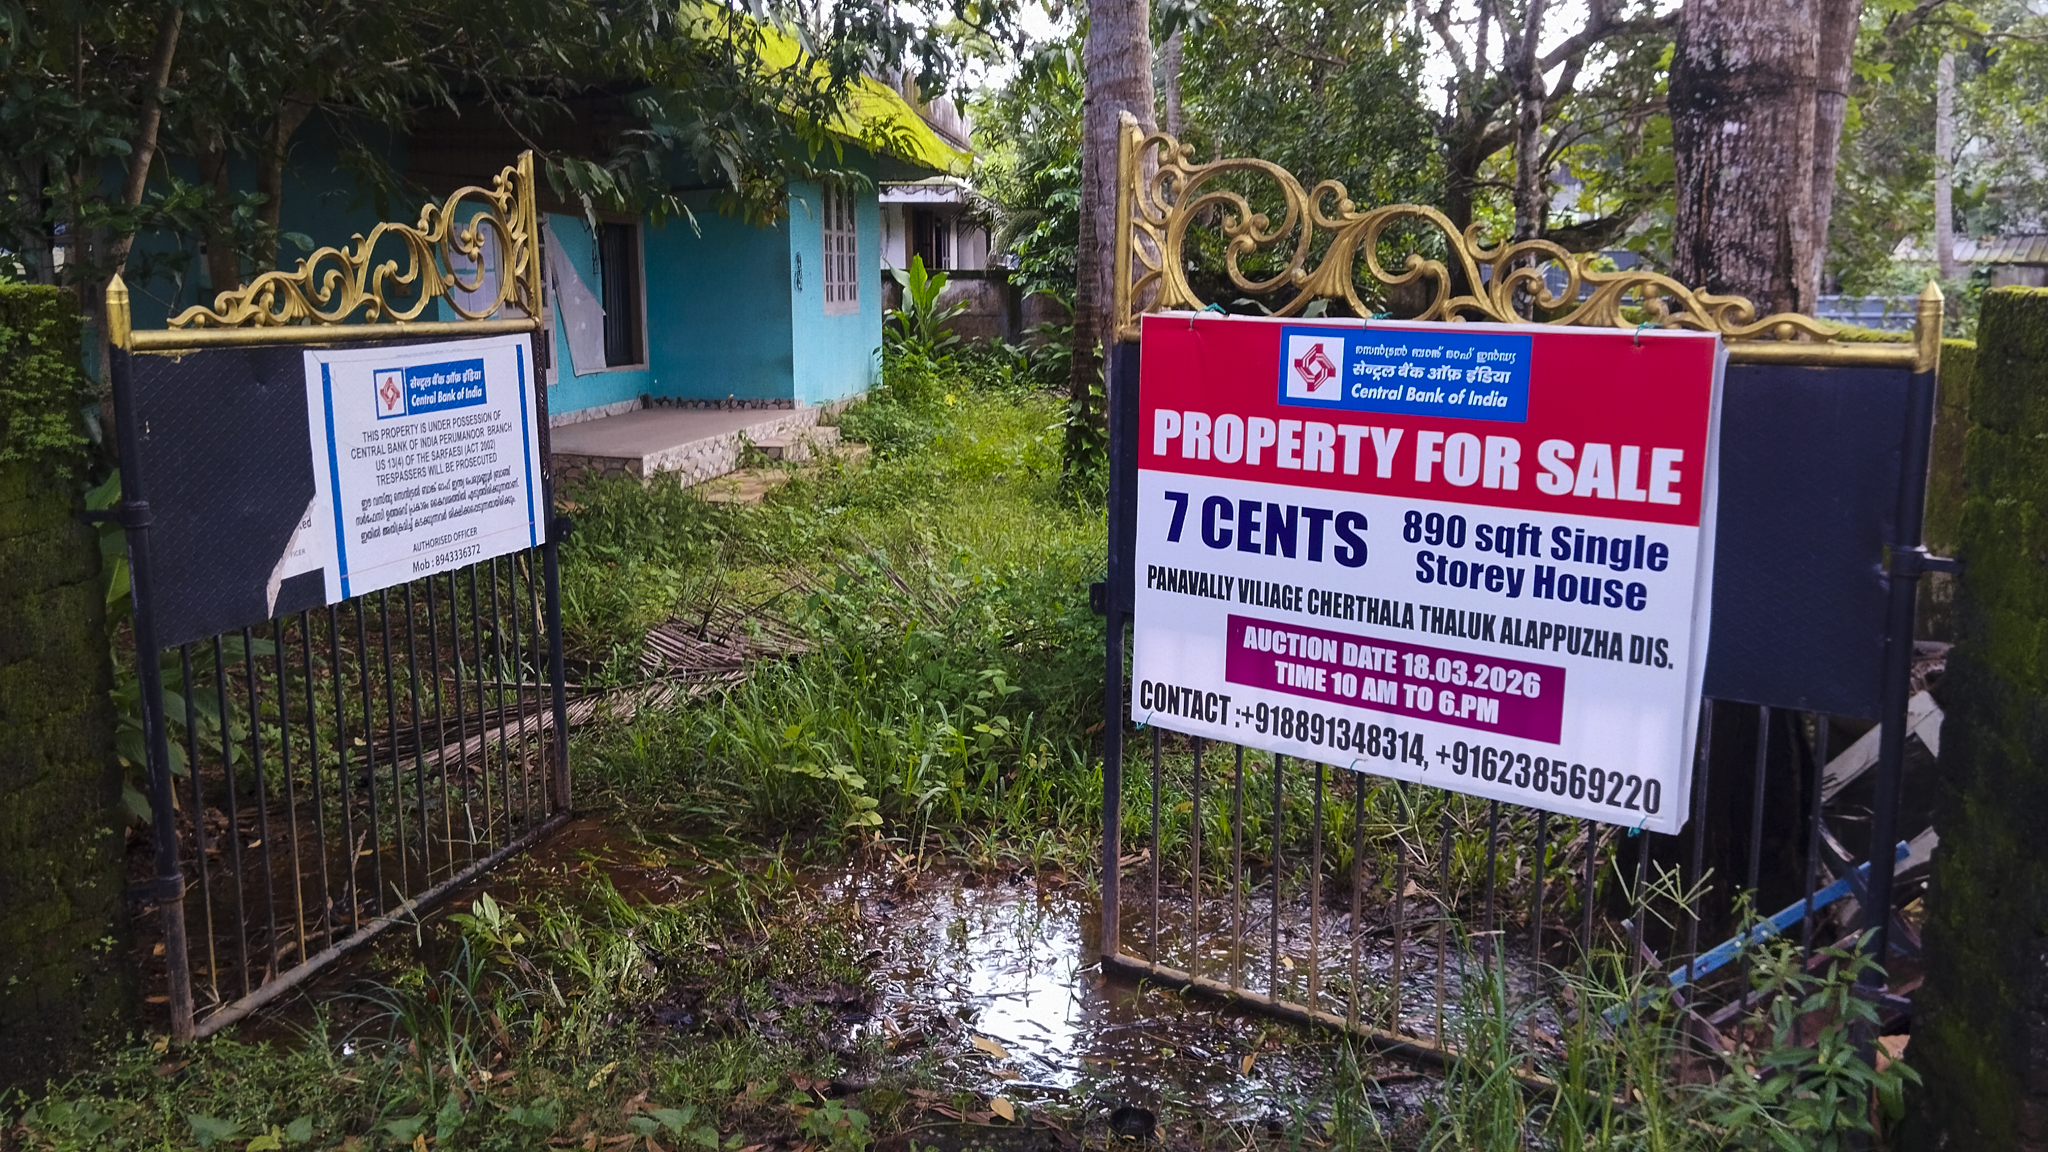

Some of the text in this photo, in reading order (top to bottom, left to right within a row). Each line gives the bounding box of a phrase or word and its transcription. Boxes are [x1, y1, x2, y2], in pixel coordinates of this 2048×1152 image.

[432, 373, 445, 385] बैंक
[463, 368, 481, 383] इंडिया
[1398, 362, 1425, 378] बैंक
[1466, 366, 1511, 383] इंडिया
[412, 385, 482, 407] Central Bank of India
[1352, 383, 1507, 407] Central Bank of India
[351, 422, 512, 459] CENTRAL BANK OF INDIA PERUMANOOR BRANCH
[362, 410, 500, 442] THIS PROPERTY IS UNDER POSSESSION OF
[376, 439, 496, 471] US 13(4) OF THE SARFAESI (ACT 2002)
[376, 453, 497, 486] TRESPASSERS WILL BE PROSECUTED
[1154, 409, 1683, 505] PROPERTY FOR SALE
[300, 516, 312, 530] ed
[413, 527, 477, 552] AUTHORISED OFFICER
[1165, 491, 1368, 568] 7 CENTS
[1403, 510, 1668, 571] 890 sqft Single
[413, 558, 430, 572] Mob
[436, 544, 480, 566] 8943336372
[1416, 551, 1647, 611] Storey House
[1148, 565, 1234, 601] PANAVALLY
[1308, 589, 1414, 630] CHERTHALA
[1419, 605, 1496, 642] THALUK
[1500, 617, 1623, 661] ALAPPUZHA
[1629, 635, 1673, 669] DIS.
[1243, 626, 1540, 698] AUCTION DATE 18.03.2026
[1275, 661, 1499, 724] TIME 10 AM TO 6.PM
[1140, 680, 1231, 725] CONTACT
[1436, 741, 1661, 814] +916238569220
